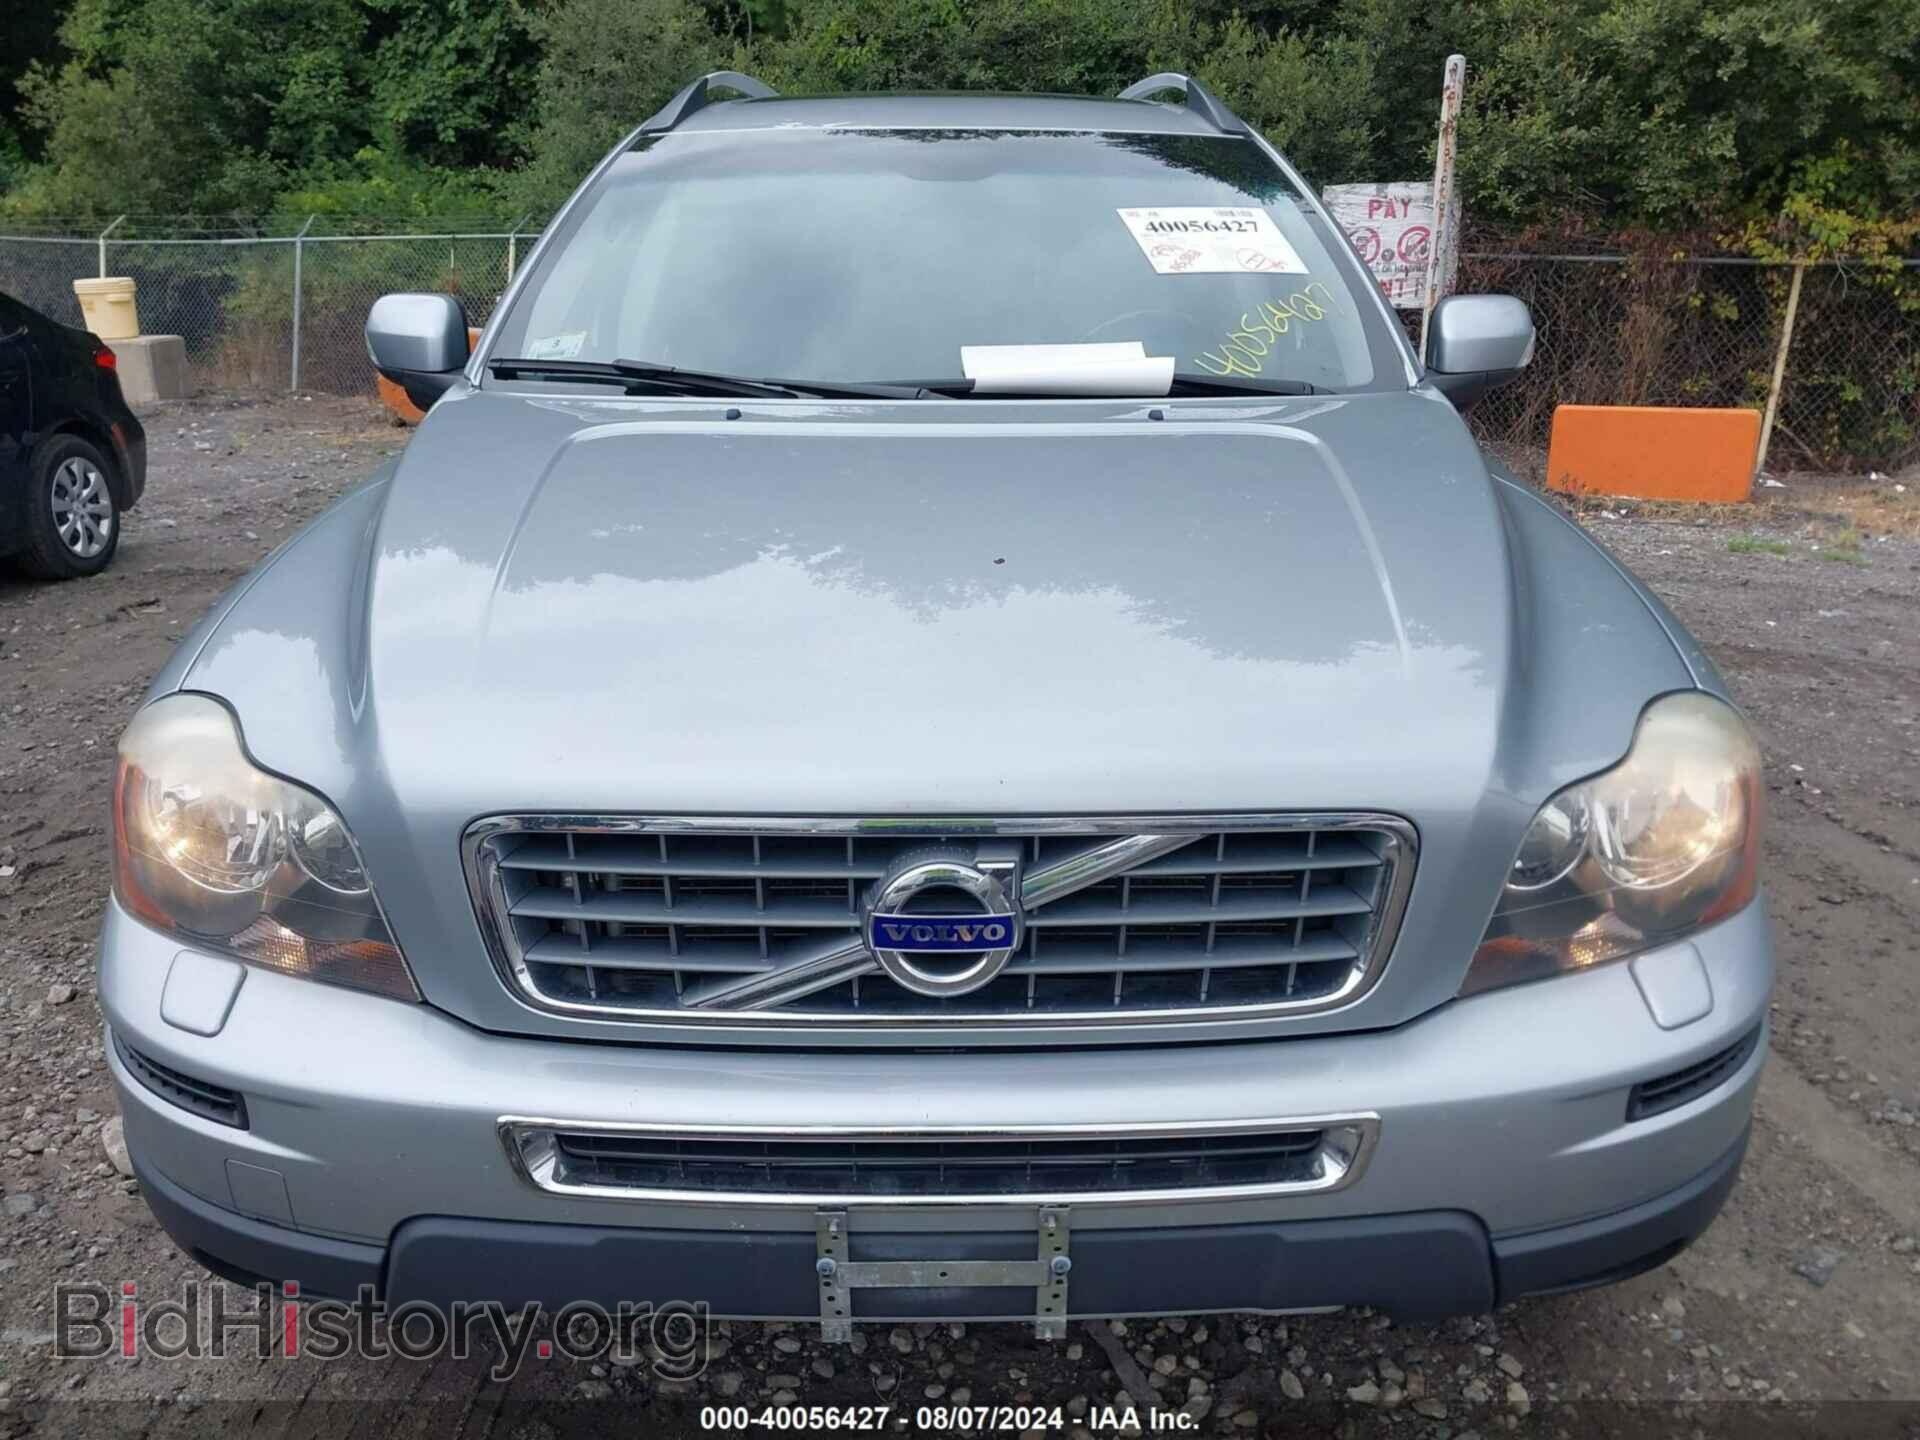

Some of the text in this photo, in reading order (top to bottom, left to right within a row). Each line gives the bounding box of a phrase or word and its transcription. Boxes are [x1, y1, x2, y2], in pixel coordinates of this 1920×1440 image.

[1367, 198, 1411, 219] PAY
[1144, 220, 1259, 233] 40056427
[1194, 282, 1335, 378] 40056427
[881, 923, 1006, 942] VOLVO
